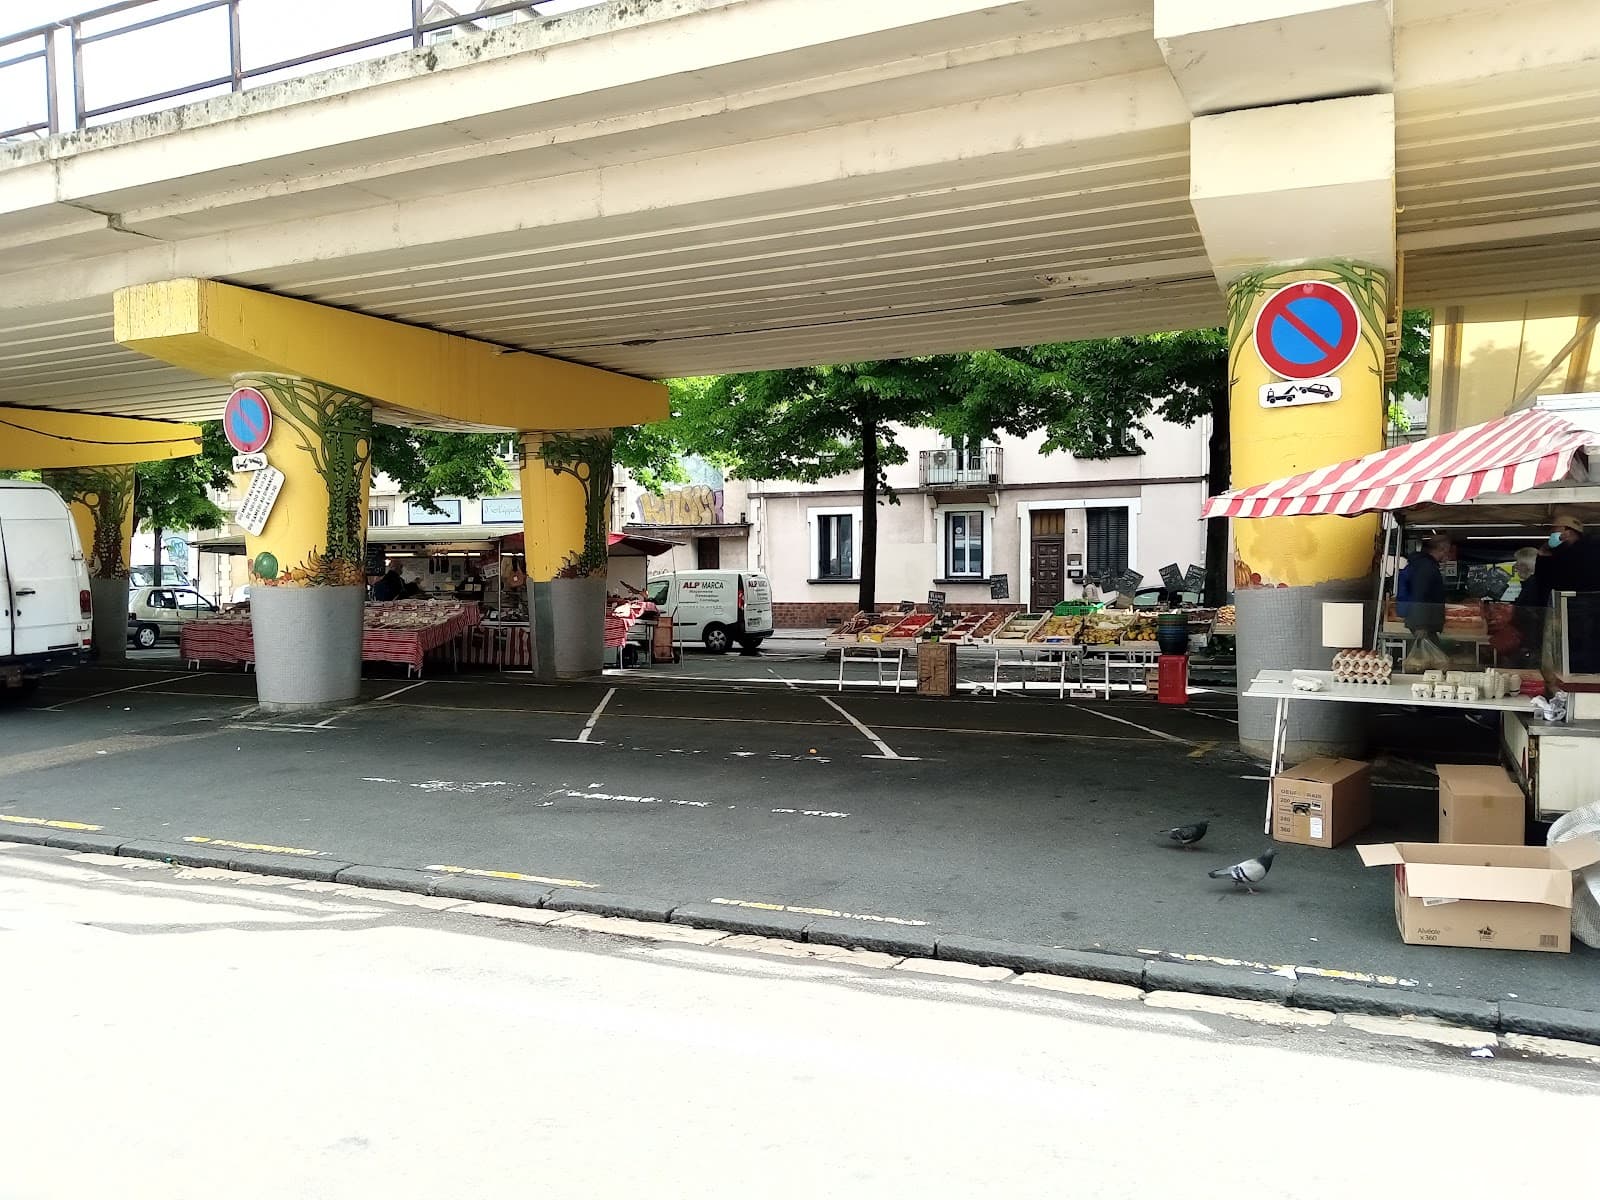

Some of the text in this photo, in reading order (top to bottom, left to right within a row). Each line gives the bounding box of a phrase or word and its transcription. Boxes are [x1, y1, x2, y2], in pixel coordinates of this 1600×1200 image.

[251, 505, 260, 522] SAMEDI
[263, 470, 276, 495] DIMANCHE
[242, 497, 250, 513] MARDI
[748, 580, 757, 588] ALP
